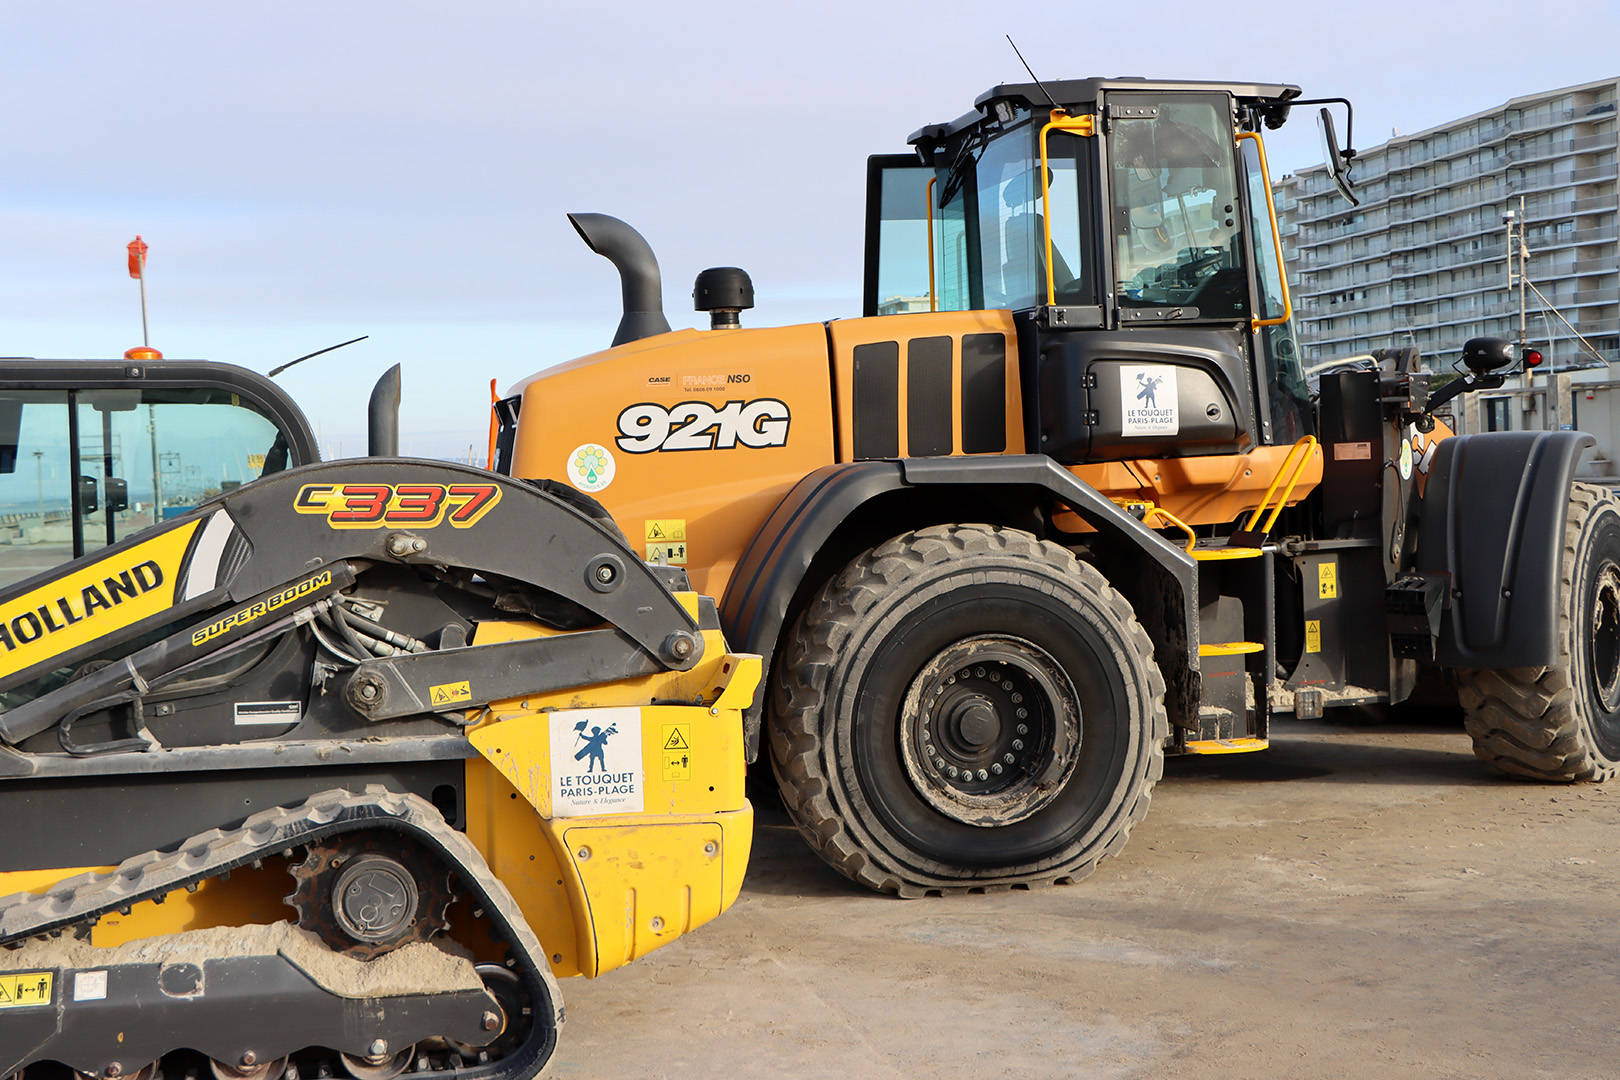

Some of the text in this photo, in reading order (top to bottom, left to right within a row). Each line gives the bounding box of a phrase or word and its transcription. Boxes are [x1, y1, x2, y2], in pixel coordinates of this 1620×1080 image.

[682, 374, 751, 386] FRANCE NSO
[1127, 409, 1173, 417] LE TOUQUET
[615, 398, 792, 454] 921G
[293, 483, 504, 530] C337
[191, 570, 333, 647] SUPER BOOM
[560, 772, 634, 787] LE TOUQUET
[560, 784, 635, 798] PARIS-PLAGE
